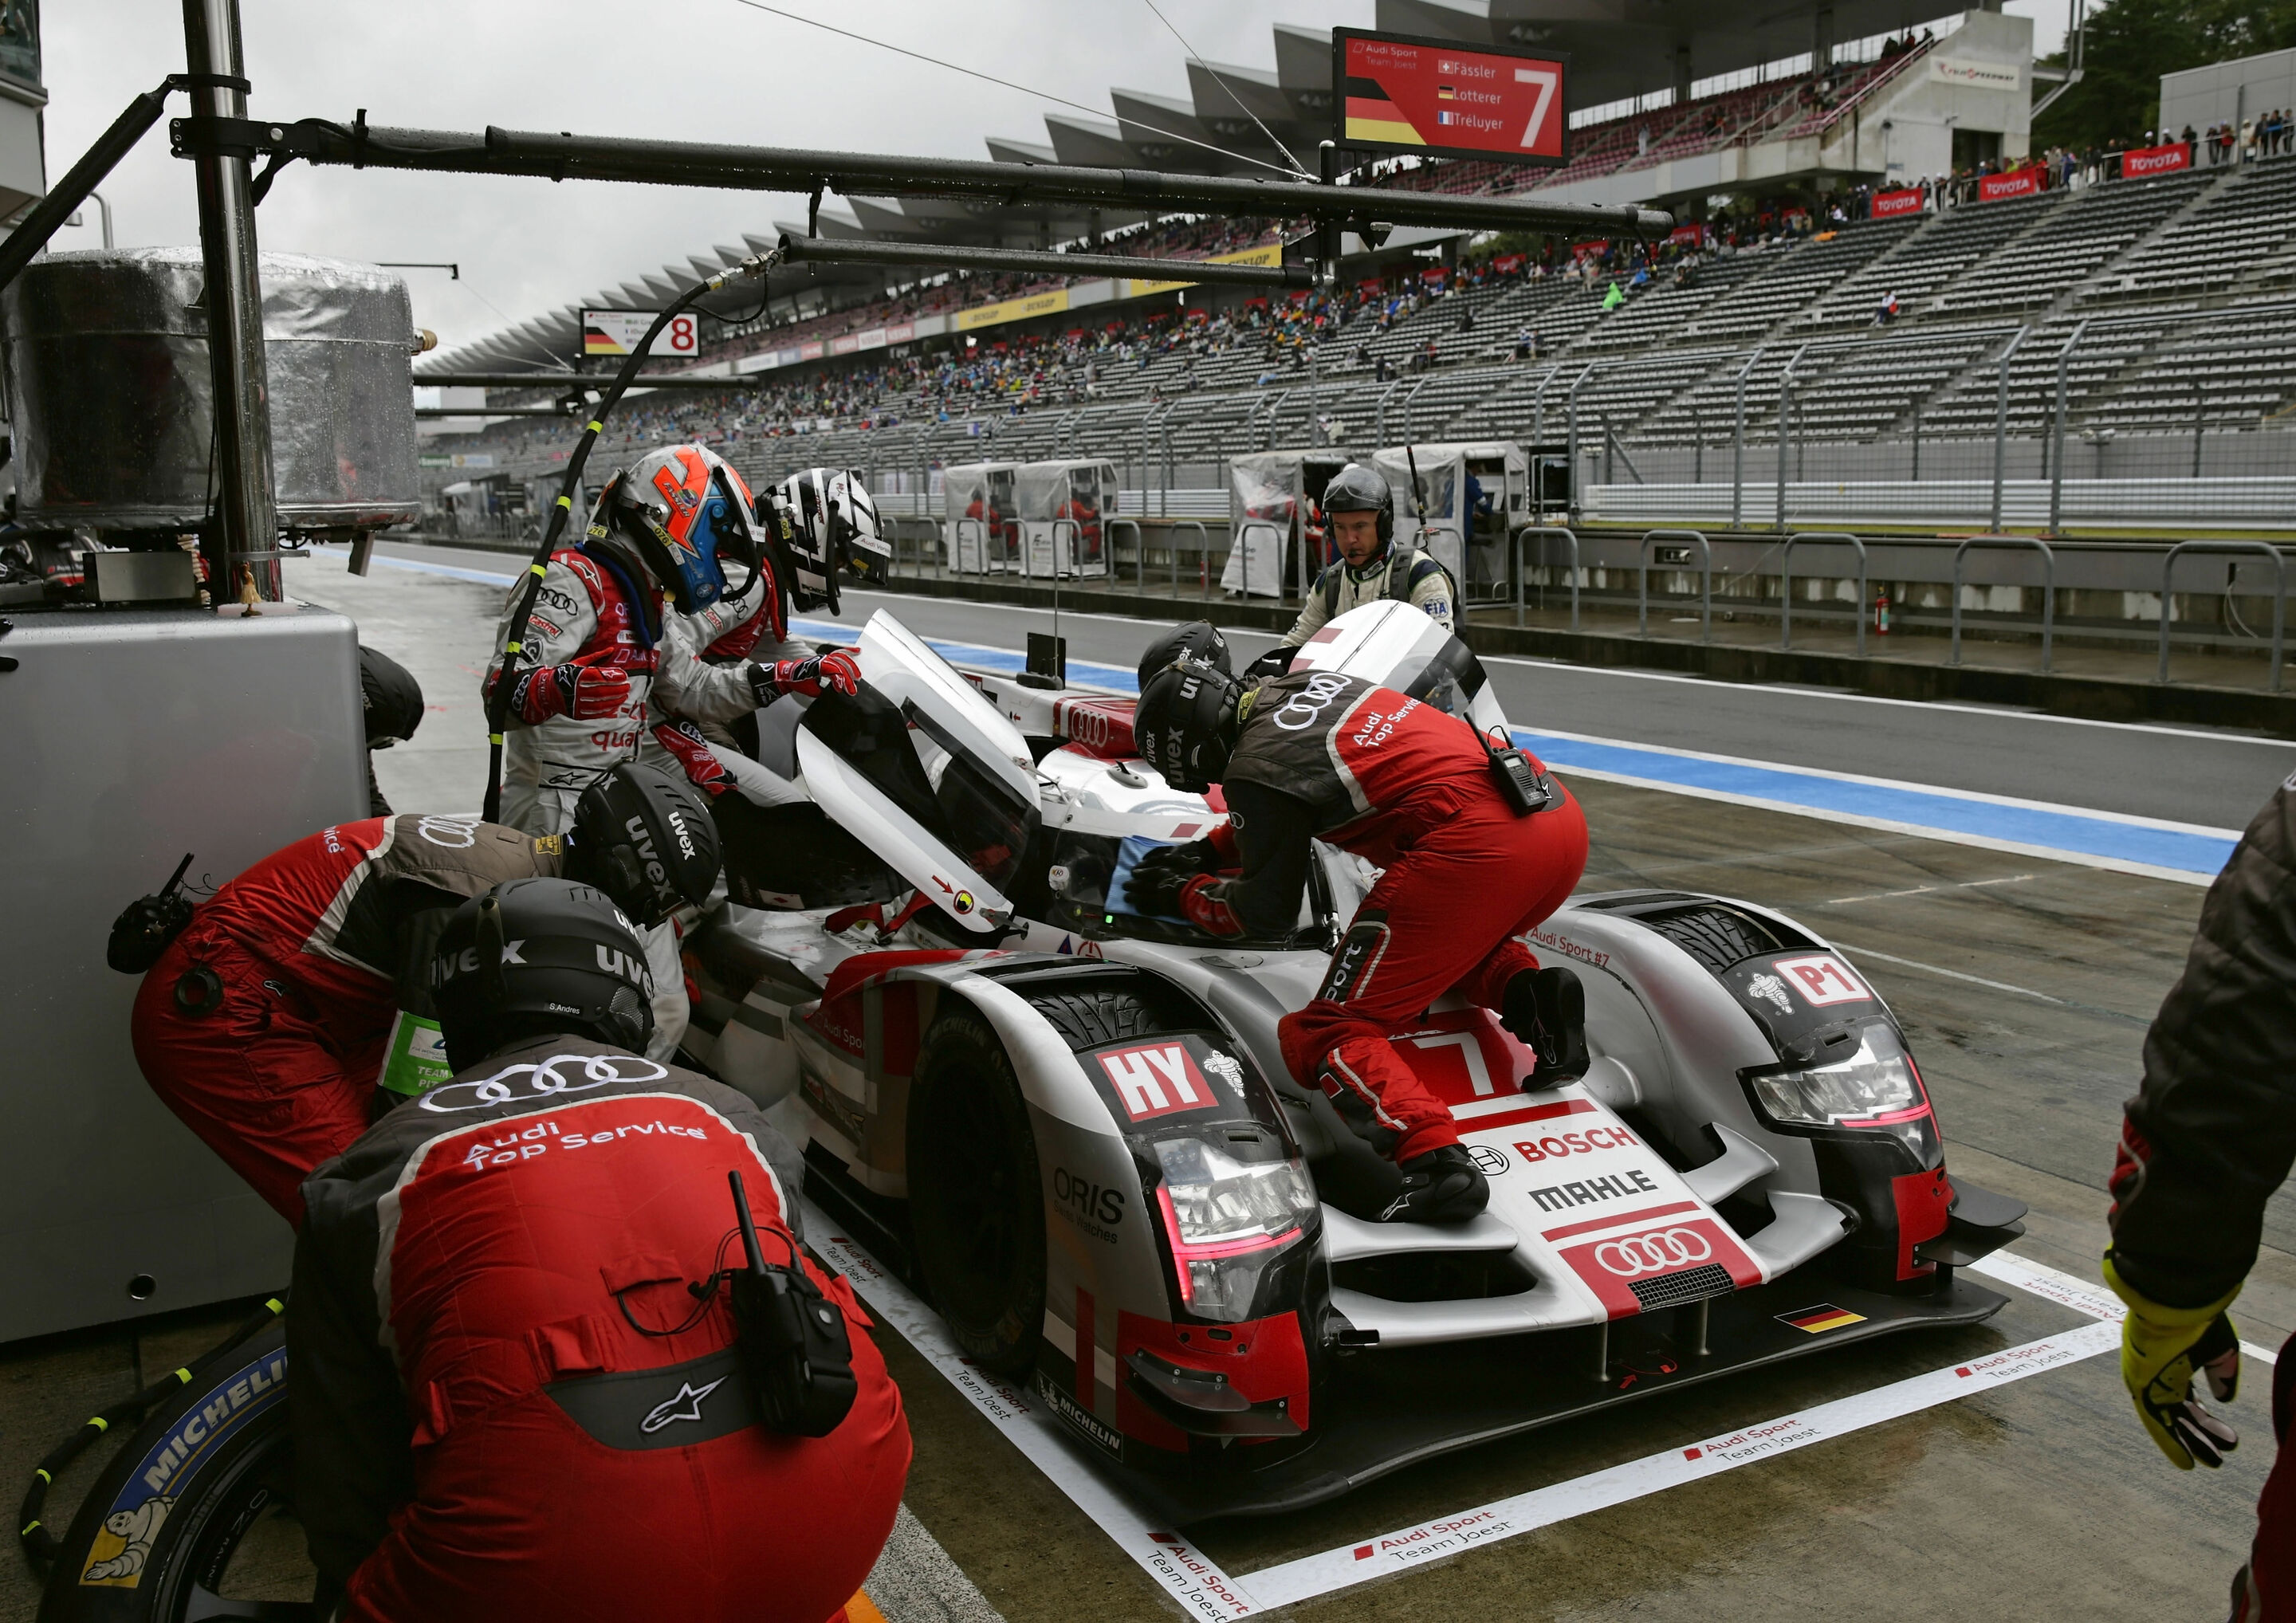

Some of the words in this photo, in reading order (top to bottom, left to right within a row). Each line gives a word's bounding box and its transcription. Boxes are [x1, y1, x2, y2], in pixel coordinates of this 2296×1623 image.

[1366, 44, 1388, 54] Audi
[1390, 46, 1418, 58] Sport
[1366, 56, 1391, 66] Team
[1453, 62, 1496, 79] Fässler
[1453, 88, 1501, 104] Lotterer
[1515, 68, 1557, 148] 7
[1453, 112, 1504, 132] Tréluyer
[2130, 151, 2182, 171] TOYOTA
[1878, 196, 1917, 212] TOYOTA
[1986, 178, 2030, 195] TOYOTA
[671, 318, 694, 351] 8
[654, 526, 670, 545] 076
[860, 537, 875, 548] Audi
[529, 616, 560, 635] Castrol
[1425, 603, 1447, 615] FIA
[1177, 646, 1193, 661] ex
[1180, 677, 1201, 700] uv
[1353, 711, 1384, 746] Audi
[1365, 723, 1394, 749] Top
[1387, 698, 1421, 723] Servic
[1145, 730, 1156, 764] uvex
[1166, 726, 1186, 784] uvex
[668, 811, 696, 861] uvex
[625, 815, 675, 902] uvex
[613, 909, 640, 942] uv
[1531, 925, 1557, 946] Audi
[1559, 936, 1592, 961] Sport
[1595, 952, 1610, 968] #7
[596, 944, 655, 1003] uve
[1325, 941, 1362, 1003] port
[1790, 962, 1857, 996] P1
[548, 1003, 580, 1016] S.Andres
[823, 1017, 842, 1039] Audi
[418, 1066, 449, 1079] TEAM
[1103, 1047, 1200, 1115] HY
[1412, 1032, 1495, 1096] 7
[463, 1142, 547, 1172] Top
[560, 1120, 708, 1149] Service
[466, 1121, 560, 1160] Audi
[1512, 1126, 1639, 1163] BOSCH
[1053, 1166, 1126, 1225] ORIS
[1527, 1169, 1659, 1212] MAHLE
[1052, 1199, 1075, 1227] Swiss
[1076, 1213, 1119, 1244] Watches
[824, 1246, 847, 1266] Team
[841, 1263, 867, 1283] Joest
[842, 1244, 863, 1260] Audi
[857, 1258, 884, 1279] Sport
[2022, 1280, 2074, 1303] Sport
[2033, 1276, 2076, 1297] Joest
[2074, 1300, 2119, 1319] Audi
[1969, 1358, 2006, 1373] Audi
[2005, 1341, 2054, 1362] Sport
[1985, 1359, 2032, 1381] Team
[2033, 1348, 2075, 1369] Joest
[955, 1370, 985, 1397] Team
[978, 1395, 1012, 1421] Joest
[997, 1386, 1032, 1414] Sport
[144, 1356, 288, 1492] MICHELI
[1060, 1398, 1121, 1451] MICHELIN
[1704, 1434, 1747, 1454] Audi
[1747, 1418, 1803, 1440] Sport
[1716, 1440, 1773, 1463] Team
[1775, 1425, 1822, 1448] Joest
[1380, 1528, 1432, 1550] Audi
[1432, 1510, 1496, 1535] Sport
[1390, 1538, 1457, 1561] Team
[1460, 1519, 1514, 1542] Joest
[1146, 1550, 1188, 1587] Team
[1181, 1586, 1229, 1623] Joest
[1168, 1545, 1204, 1576] Audi
[1201, 1574, 1250, 1615] Sport
